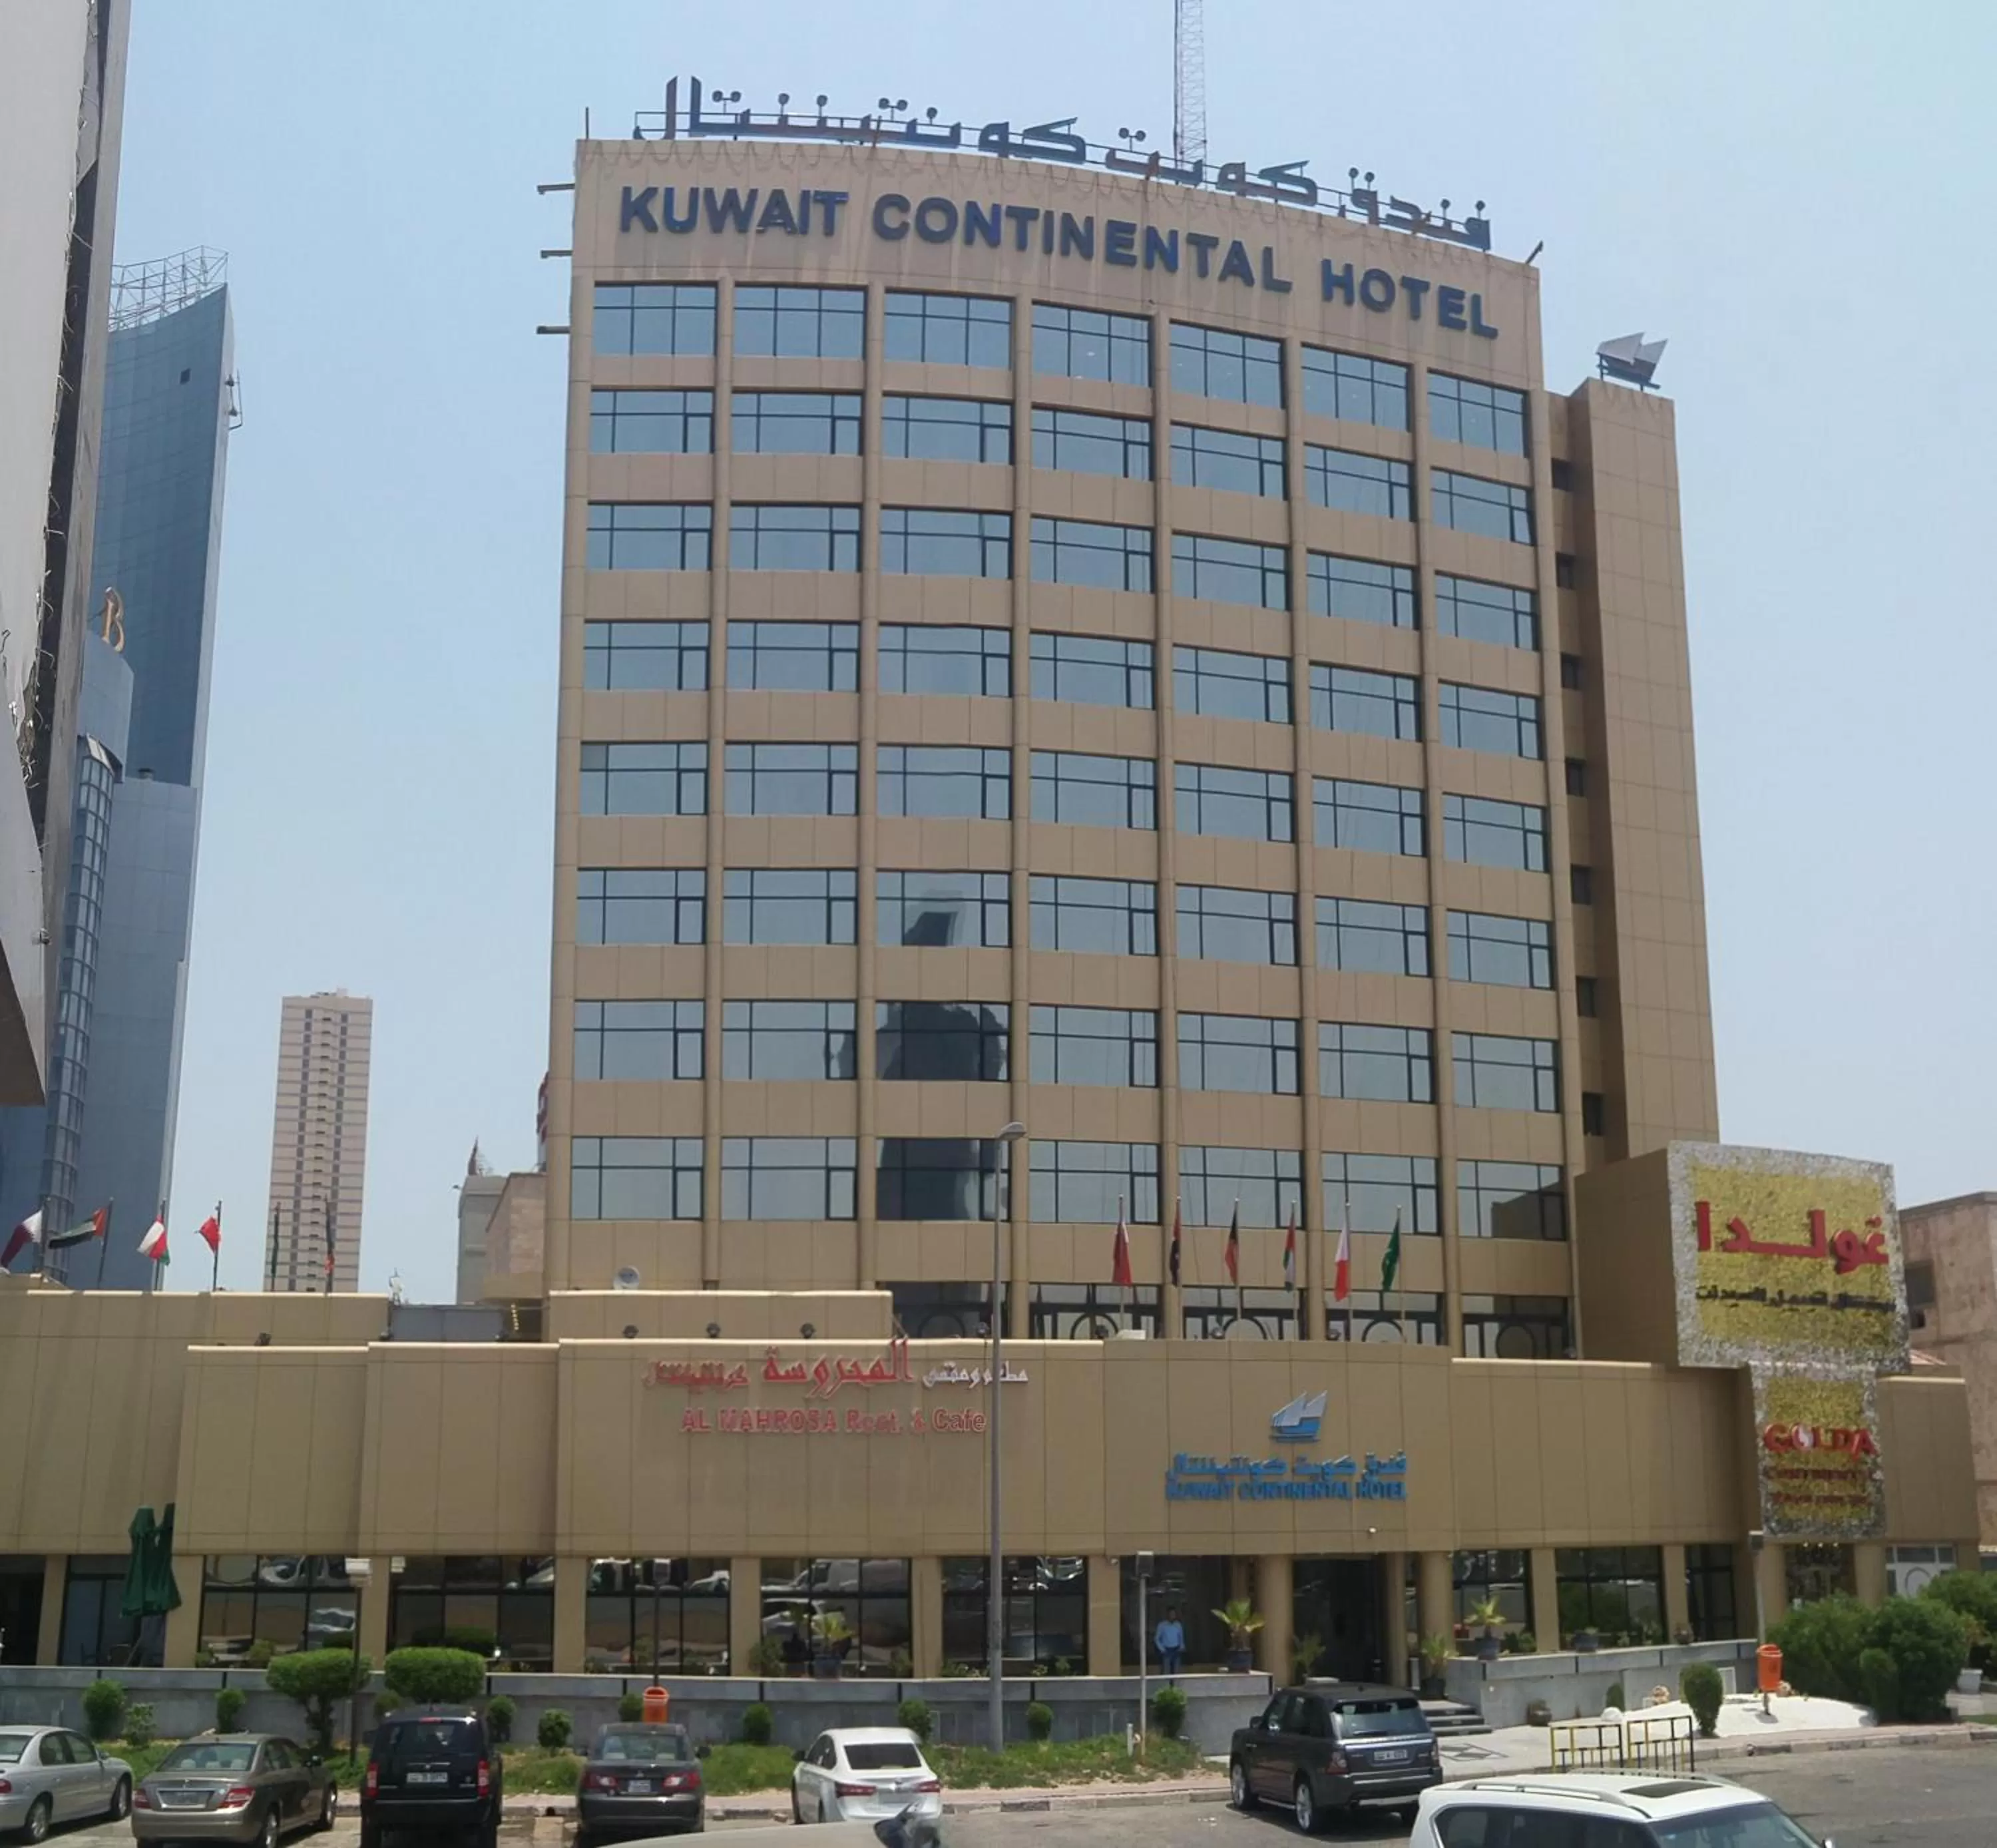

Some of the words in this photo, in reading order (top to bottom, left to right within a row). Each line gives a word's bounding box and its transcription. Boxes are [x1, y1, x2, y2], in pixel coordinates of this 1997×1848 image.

[1339, 167, 1490, 250] فندق
[620, 186, 849, 236] KUWAIT
[873, 193, 1293, 294] CONTINENTAL
[1321, 258, 1499, 340] HOTEL
[762, 1334, 916, 1399] المحروسة
[983, 1360, 1029, 1385] مطم
[681, 1407, 711, 1433] AL
[718, 1407, 838, 1433] MAHROSA
[933, 1407, 987, 1433] Cafe
[1764, 1423, 1879, 1461] GOLDA
[1167, 1482, 1235, 1502] KUWAIT
[1239, 1482, 1355, 1501] CONTINENTAL
[1356, 1481, 1407, 1501] HOTEL
